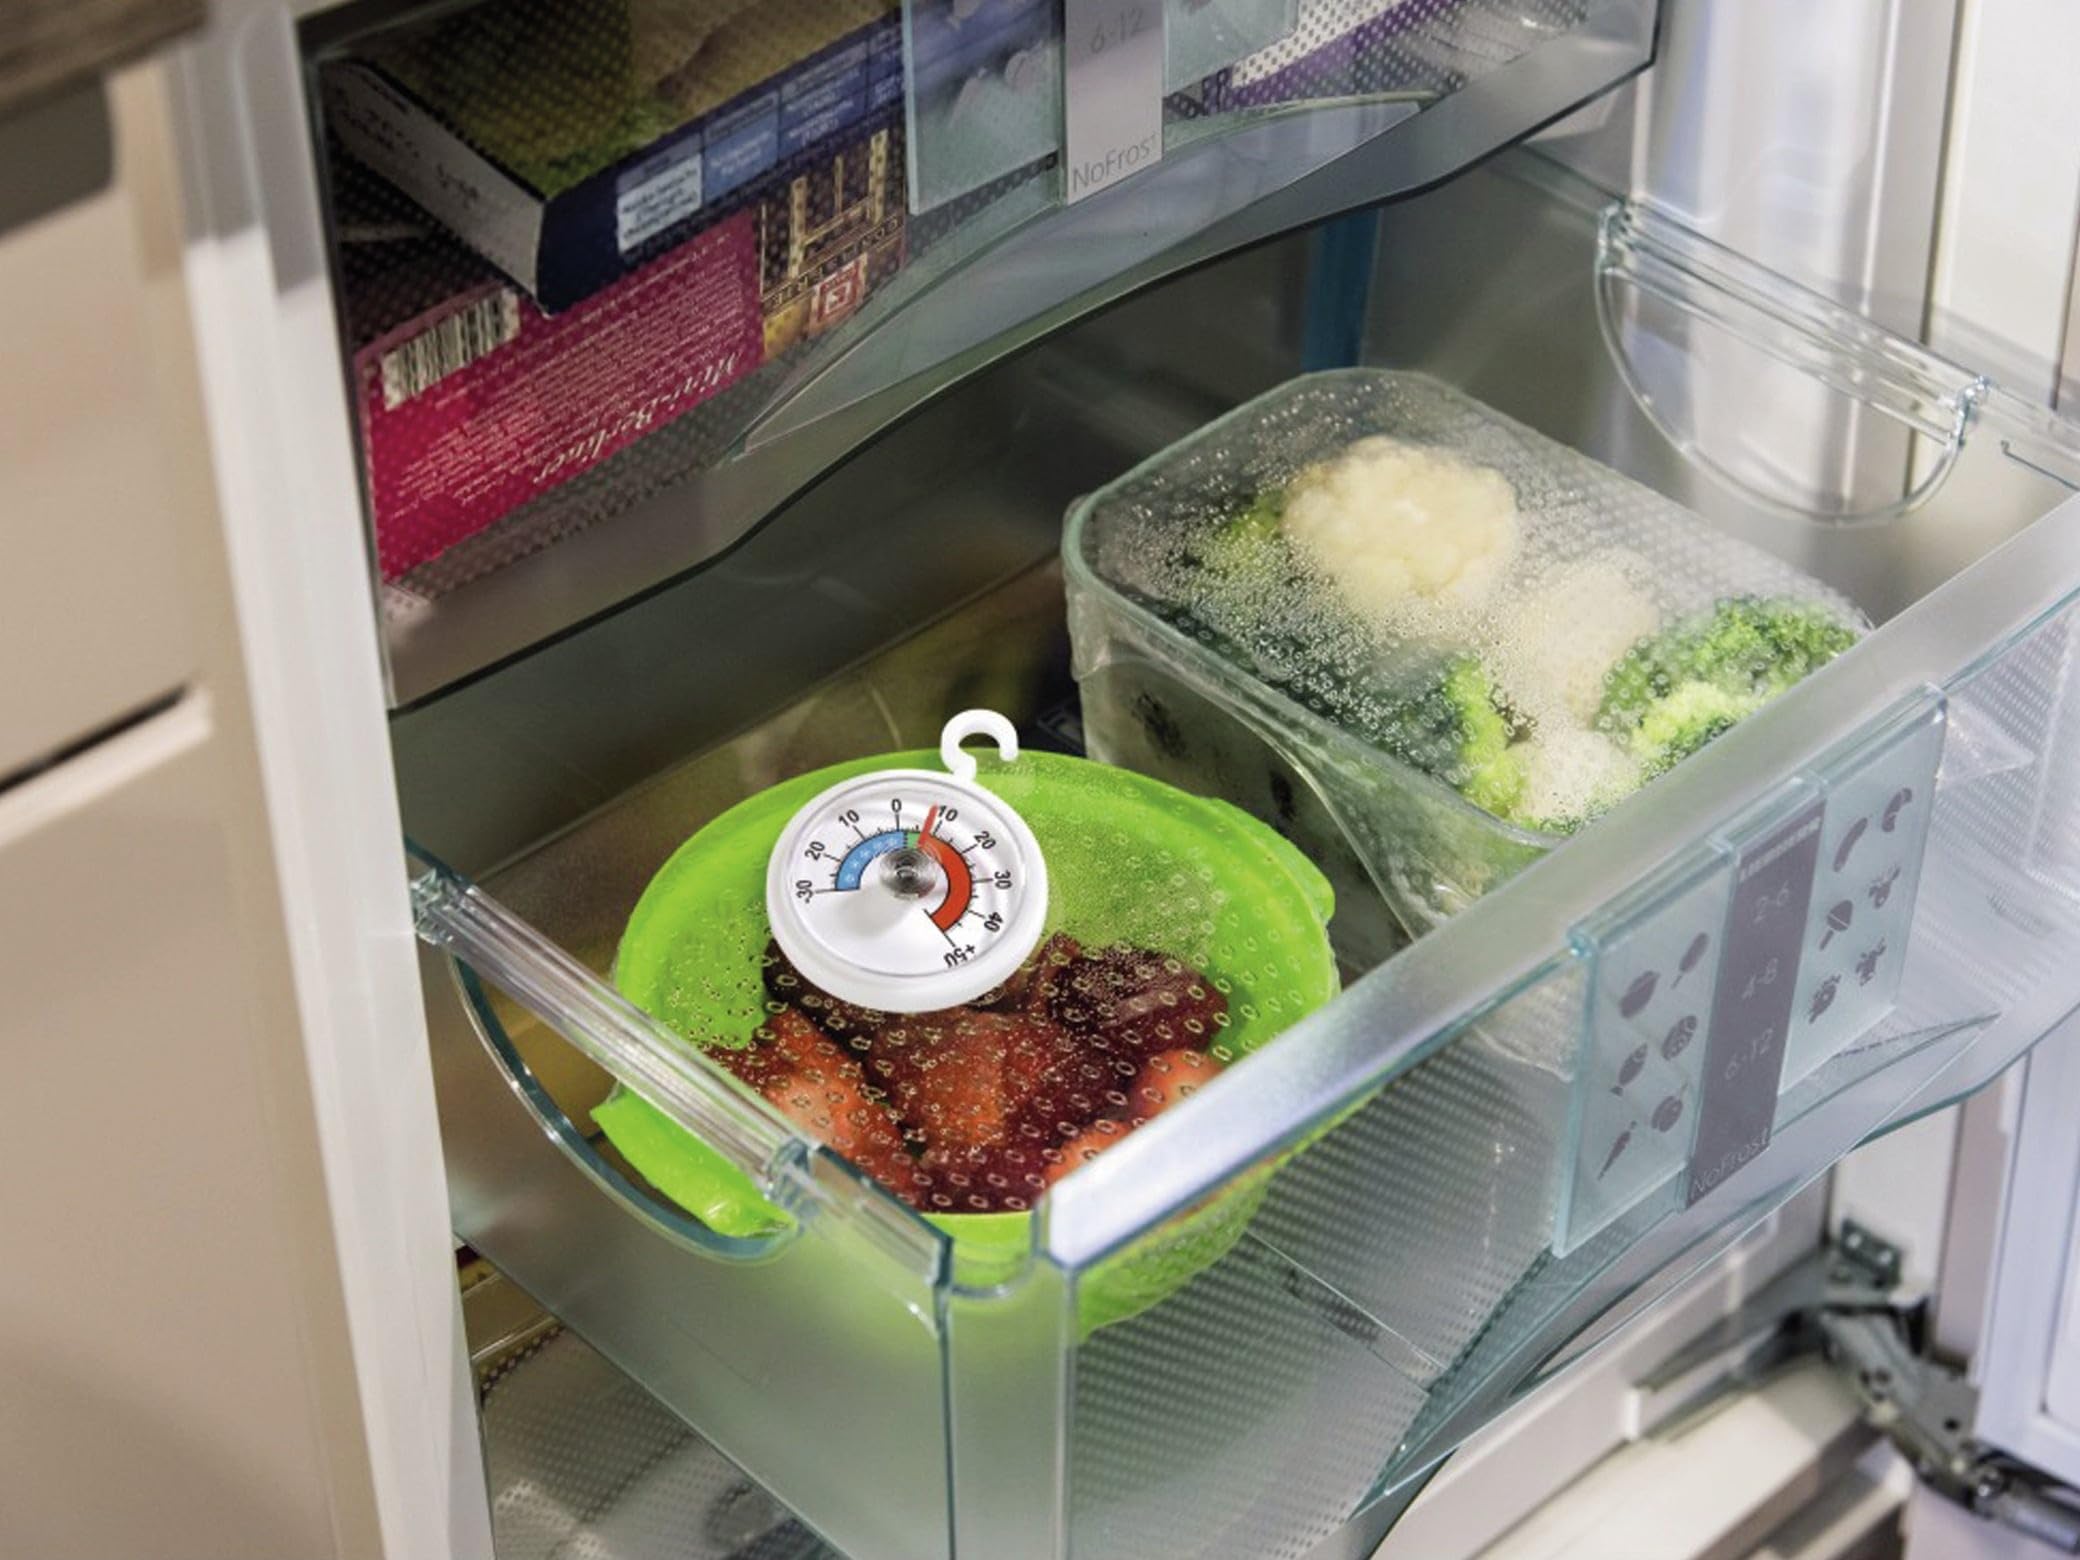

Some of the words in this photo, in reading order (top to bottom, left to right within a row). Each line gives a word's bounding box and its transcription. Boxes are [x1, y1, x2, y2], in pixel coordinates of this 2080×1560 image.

[532, 351, 743, 484] Mini-Berliner
[891, 799, 902, 813] 0
[938, 804, 958, 822] 10
[838, 809, 860, 827] 10
[974, 830, 996, 850] 20
[804, 840, 826, 861] 20
[994, 869, 1012, 889] 30
[983, 911, 1004, 933] 40
[942, 943, 977, 968] +50
[1690, 1127, 1770, 1199] NoFrost
